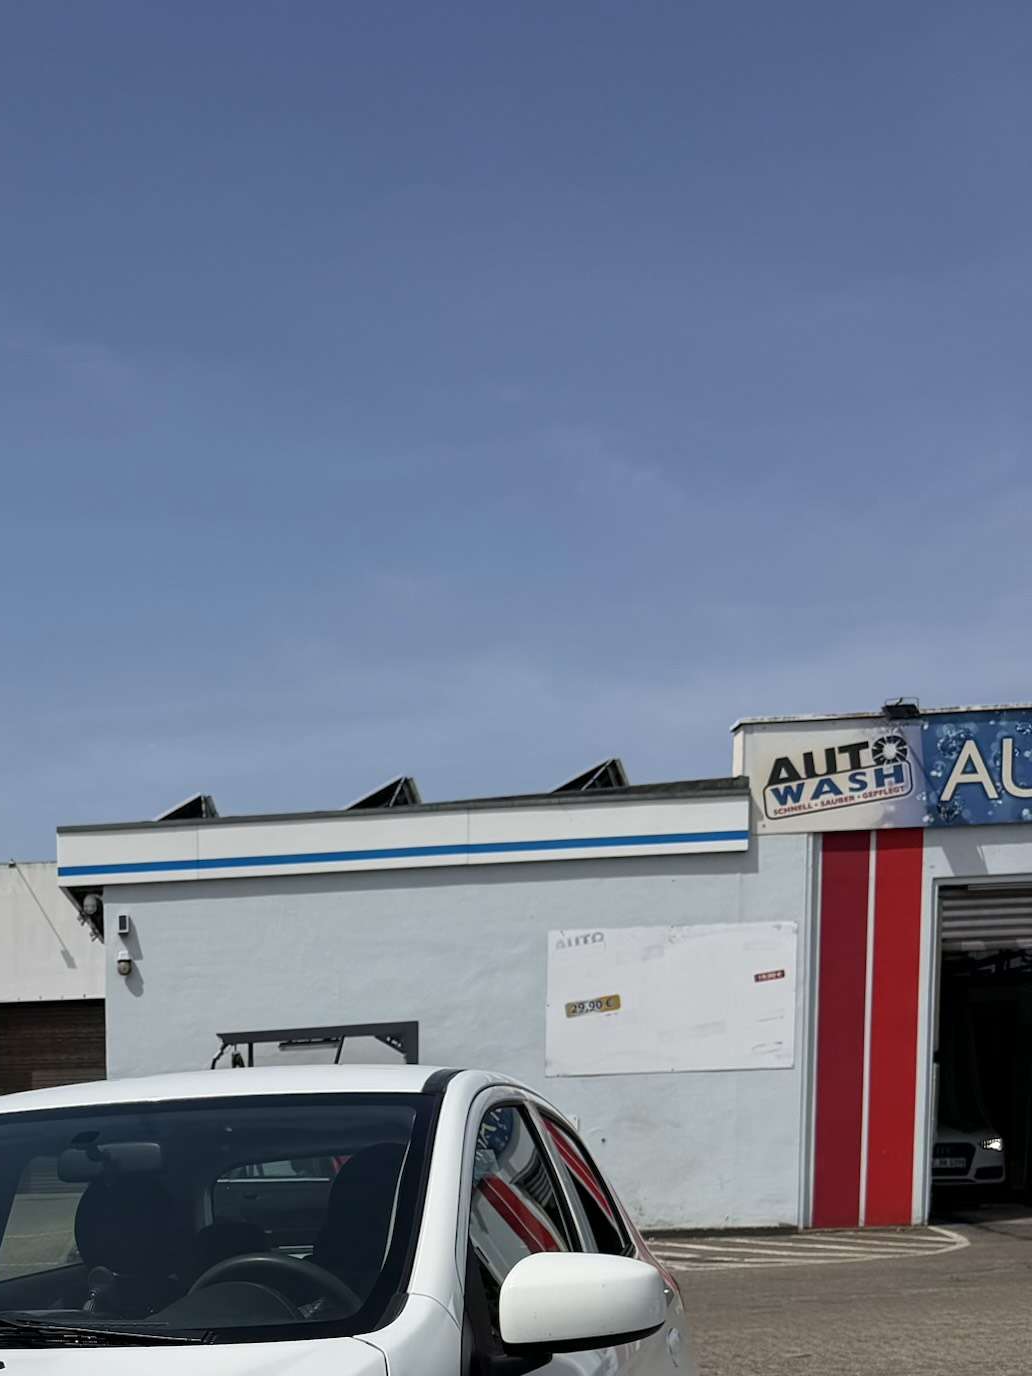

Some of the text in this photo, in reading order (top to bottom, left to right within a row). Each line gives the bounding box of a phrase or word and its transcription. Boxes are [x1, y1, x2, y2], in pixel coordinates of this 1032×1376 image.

[768, 735, 908, 786] AUTO
[770, 764, 905, 806] WASH
[774, 786, 905, 816] SCHNELL SAUBER GEPFLEGT
[570, 999, 603, 1014] 29,90
